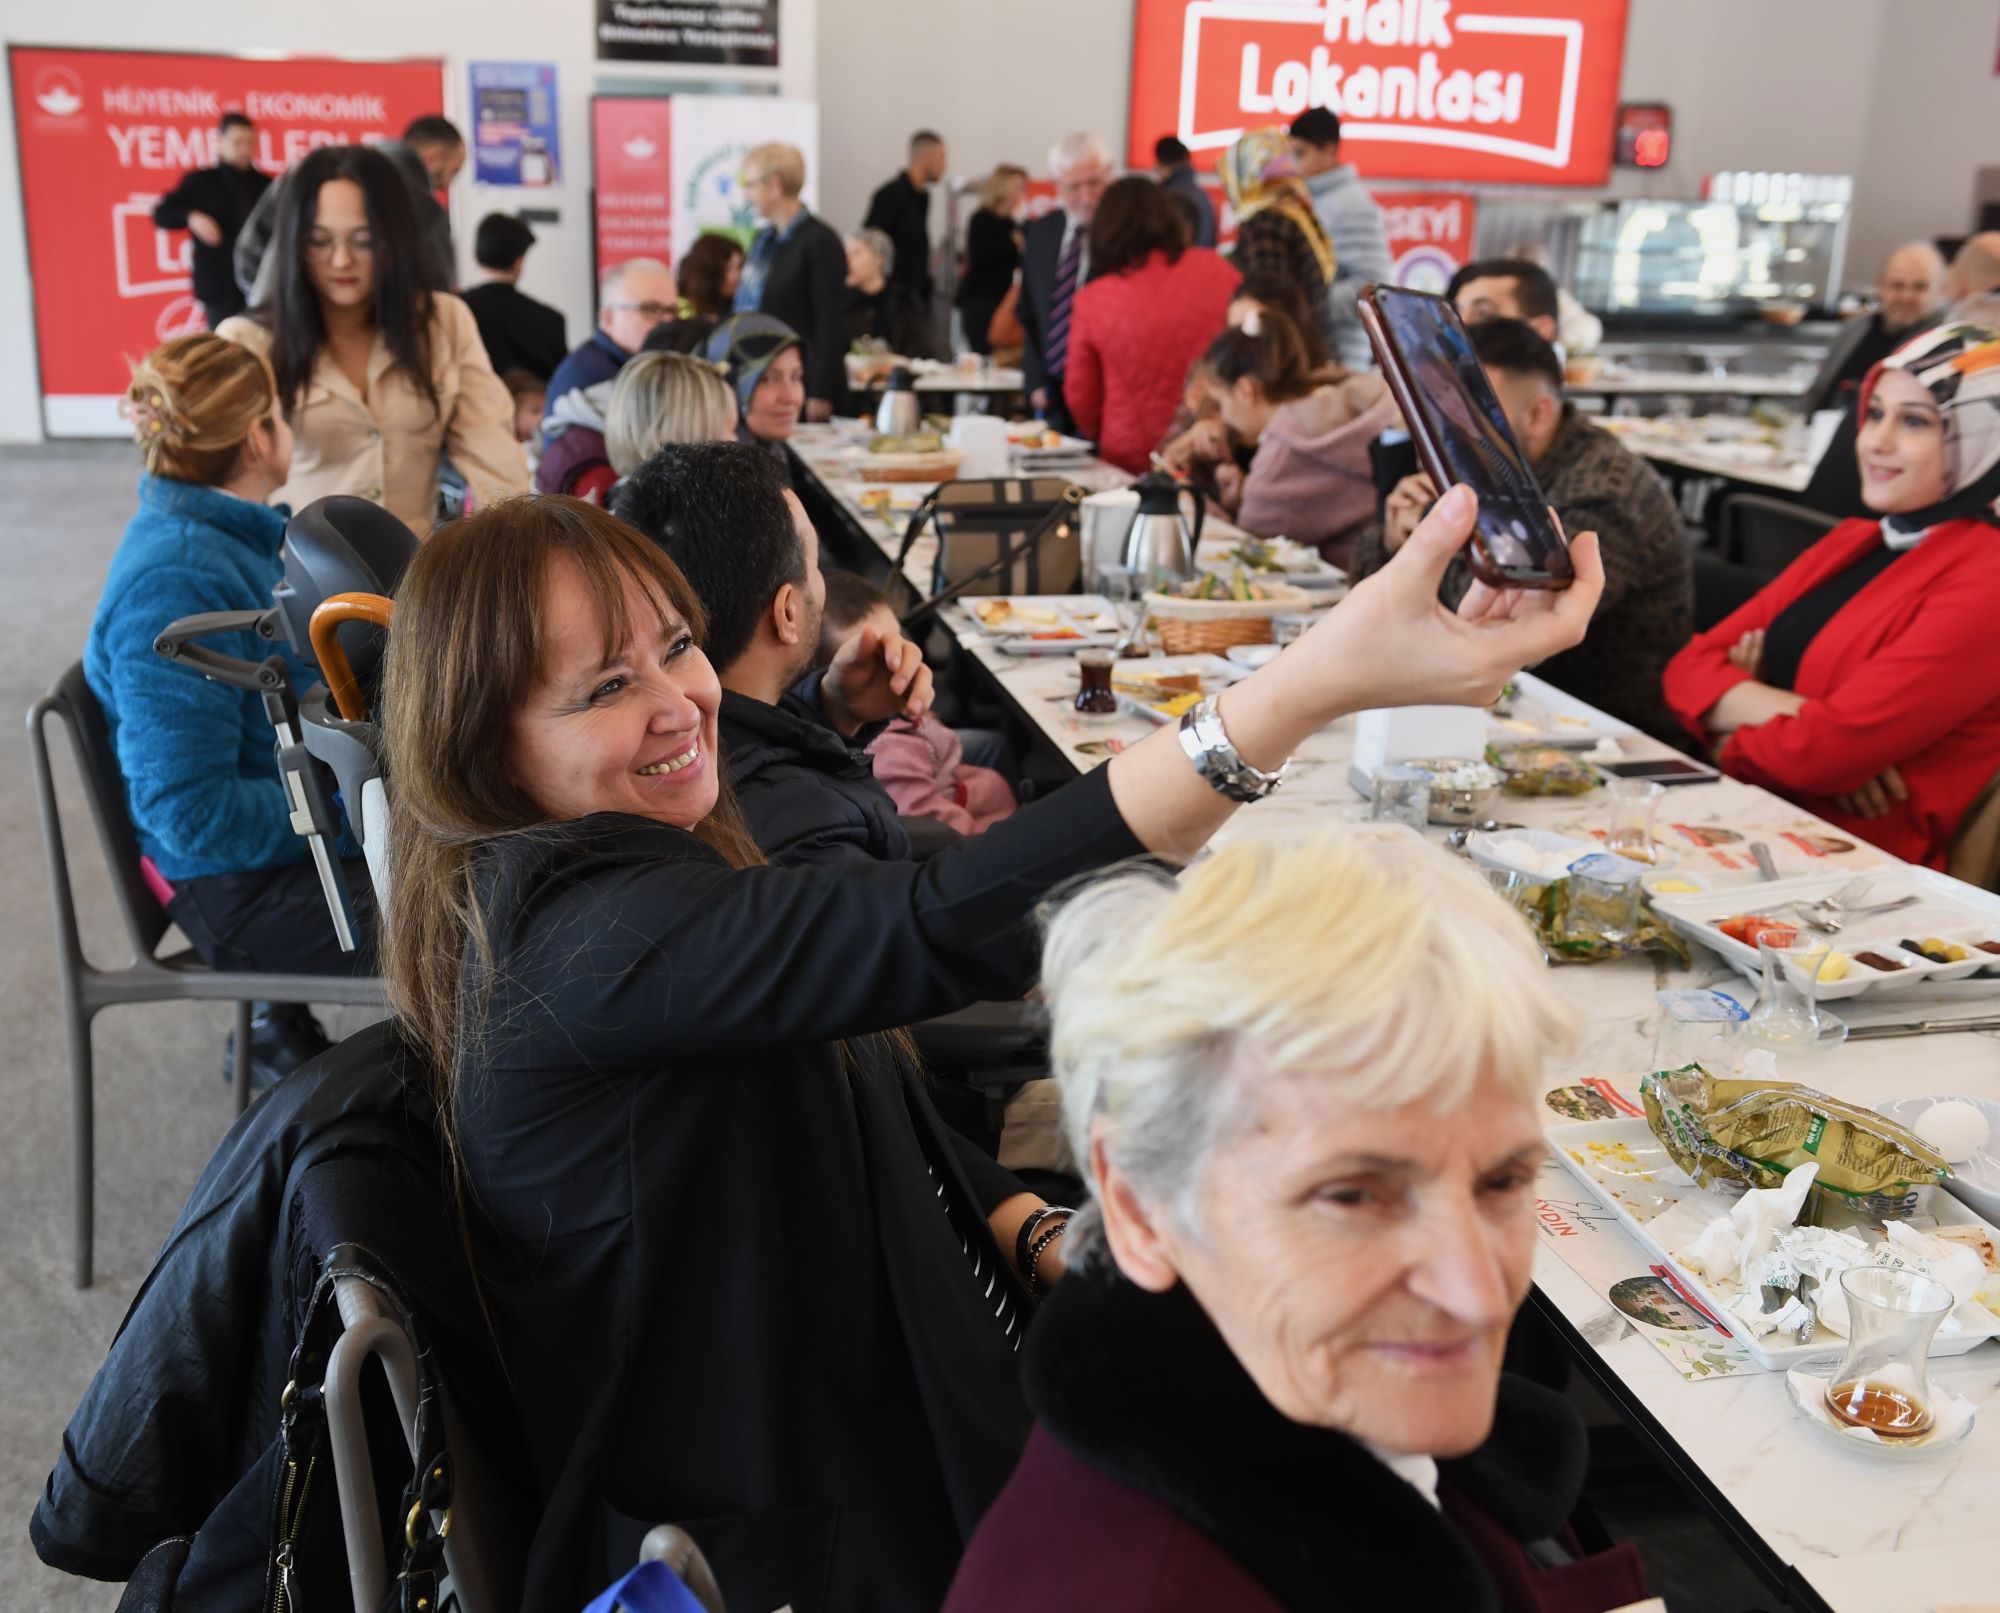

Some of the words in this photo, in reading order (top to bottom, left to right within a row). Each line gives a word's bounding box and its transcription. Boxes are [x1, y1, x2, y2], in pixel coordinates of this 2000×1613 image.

[1323, 0, 1453, 48] Halk
[245, 90, 388, 122] EKONOMİK
[1239, 42, 1524, 124] Lokantası
